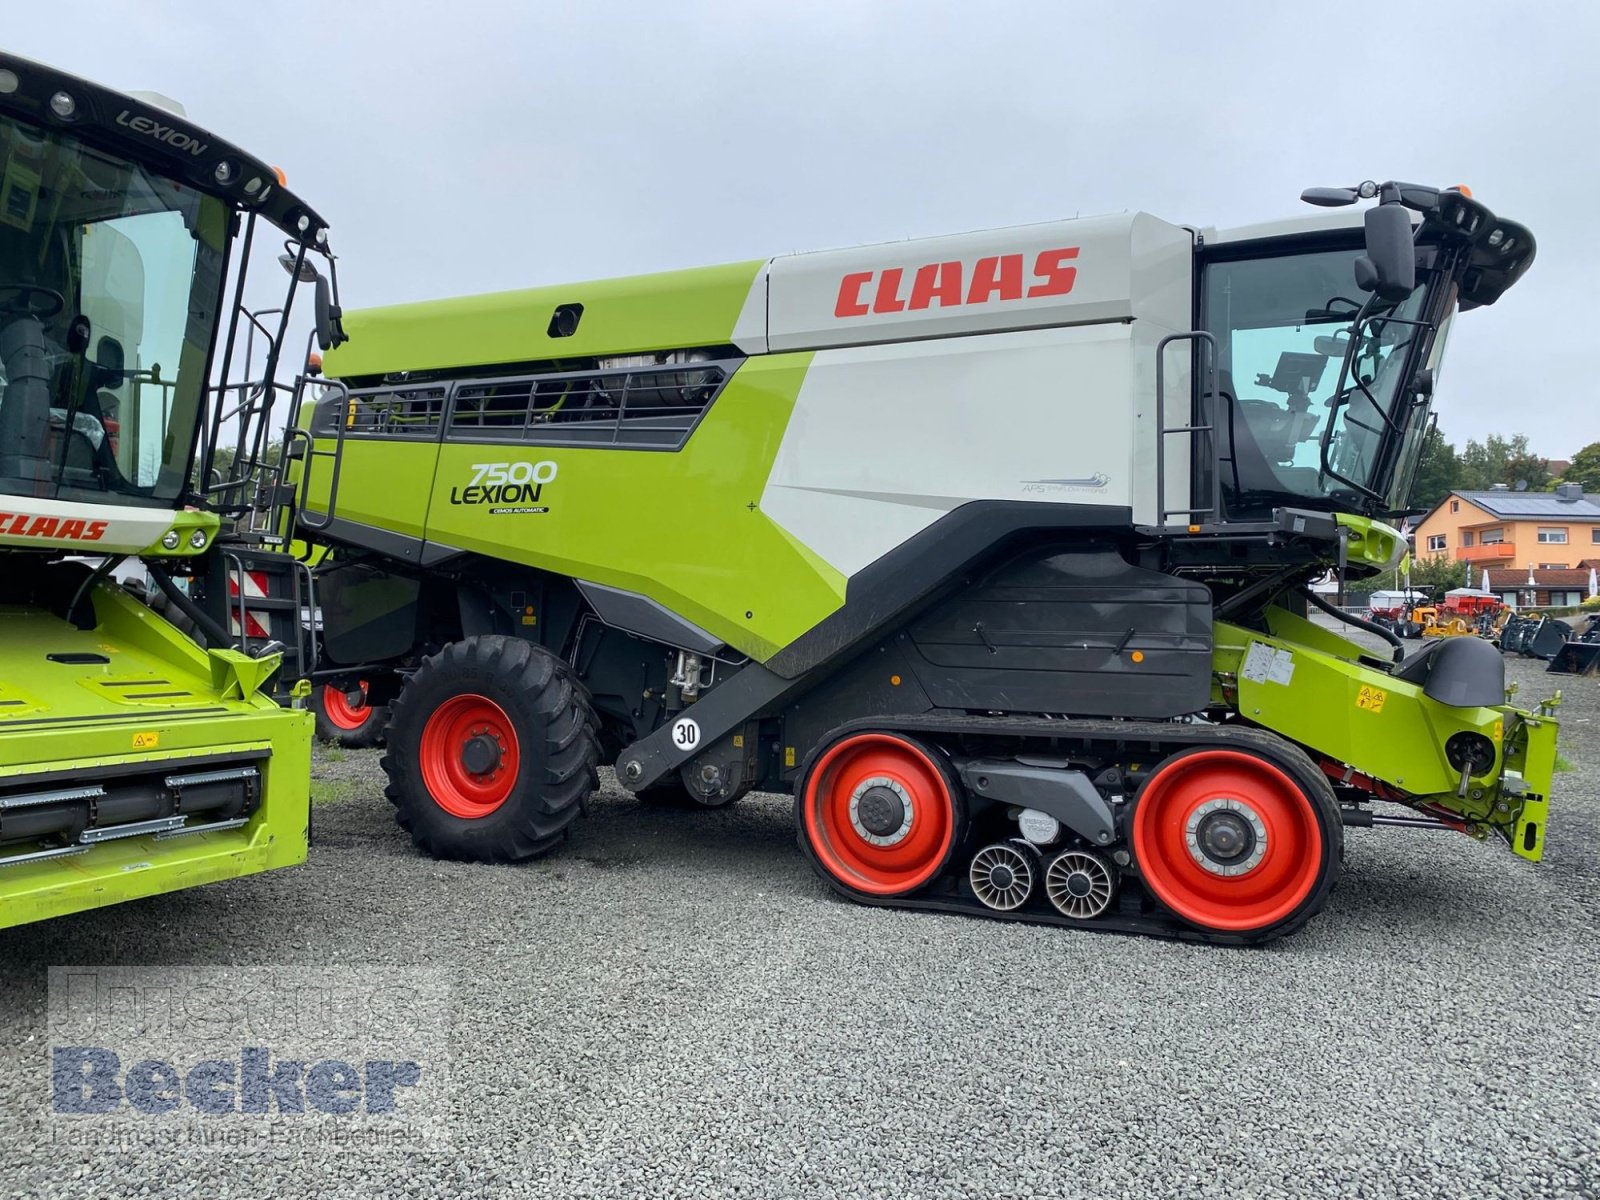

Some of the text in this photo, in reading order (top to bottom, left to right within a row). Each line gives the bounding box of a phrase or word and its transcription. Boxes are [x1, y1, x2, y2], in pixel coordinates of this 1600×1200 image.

[115, 110, 208, 156] LEXION
[834, 247, 1080, 317] CLAAS
[469, 461, 558, 487] 7500
[450, 484, 542, 504] LEXION
[676, 724, 696, 744] 30
